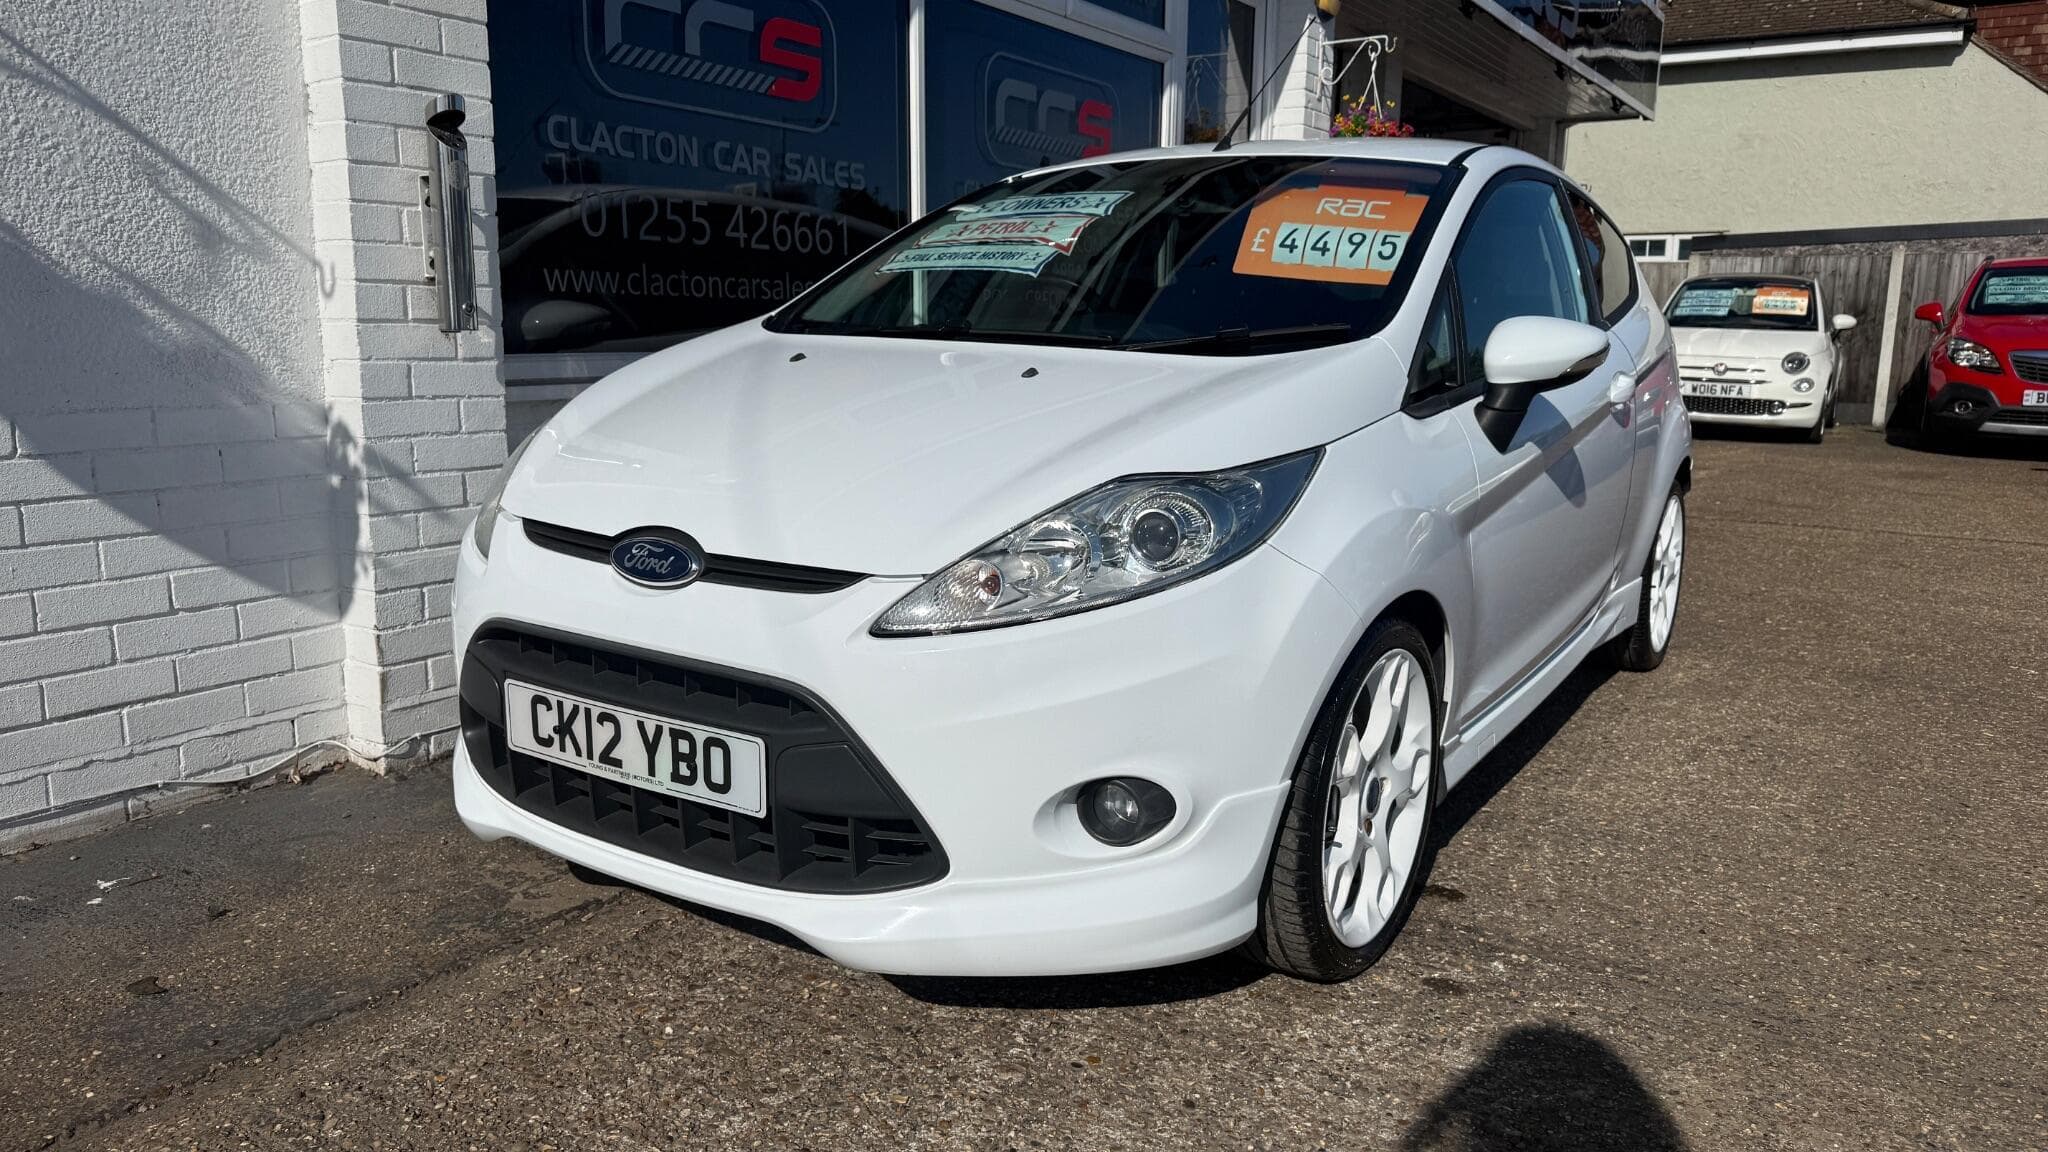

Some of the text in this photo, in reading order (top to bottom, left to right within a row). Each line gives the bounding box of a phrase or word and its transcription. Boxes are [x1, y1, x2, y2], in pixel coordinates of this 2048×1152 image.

[546, 114, 866, 190] CLACTON CAR SALES
[1000, 196, 1087, 212] OWNERS
[580, 191, 850, 257] 01255 426661
[968, 221, 1033, 236] PETROL
[938, 251, 979, 262] SERVICE
[980, 251, 1026, 262] HISTORY
[1720, 384, 1744, 396] NFA
[624, 543, 675, 575] Ford
[530, 694, 732, 795] CK12 YBO
[655, 779, 665, 787] LTD
